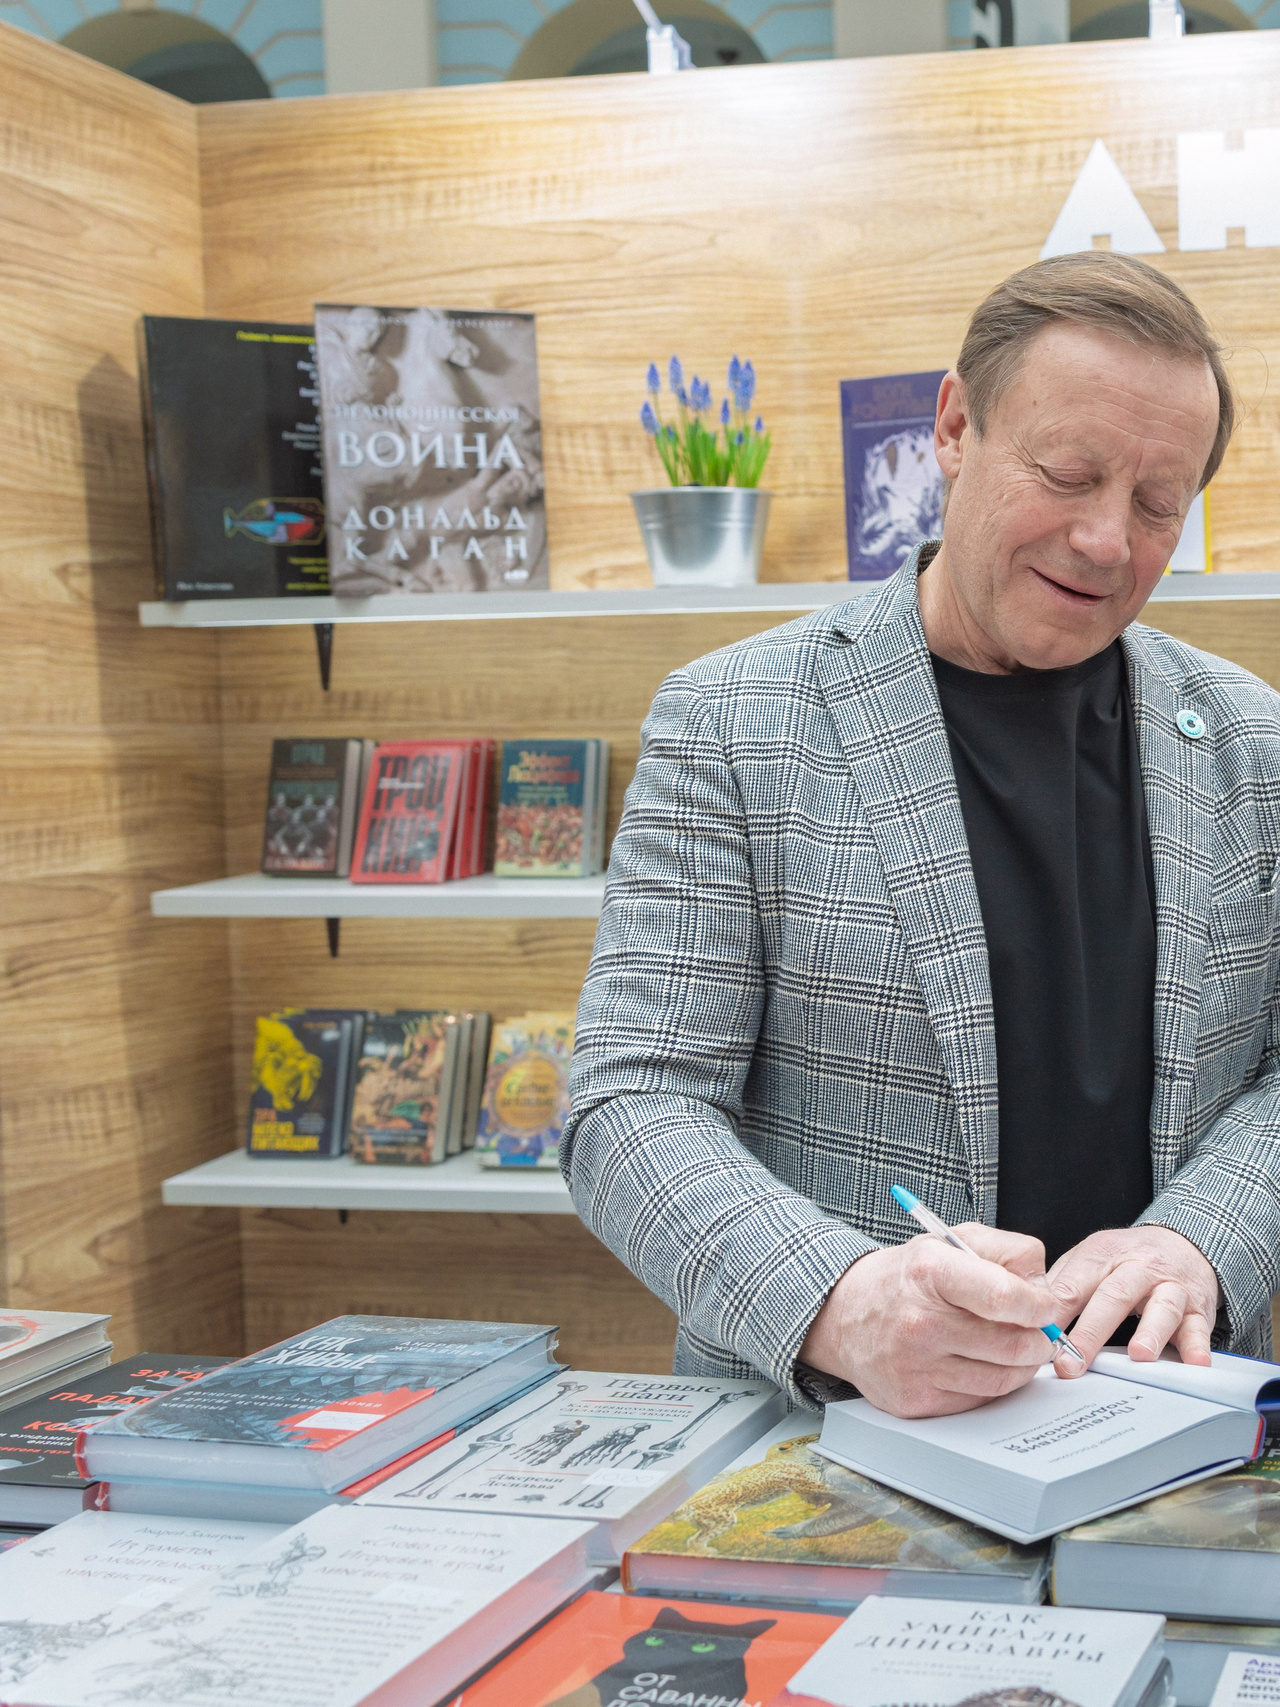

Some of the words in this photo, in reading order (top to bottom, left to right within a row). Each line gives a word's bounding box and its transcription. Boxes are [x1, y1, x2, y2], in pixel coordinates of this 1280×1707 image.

[338, 425, 525, 469] ВОЙНА
[342, 505, 528, 532] ДОНАЛЬД
[345, 535, 529, 560] КАГАН
[288, 1336, 365, 1351] КАК
[254, 1350, 388, 1369] ЖИВЫЕ
[130, 1369, 204, 1381] ЗАГА
[603, 1378, 721, 1393] Первые
[49, 1392, 155, 1404] ПАДА
[608, 1391, 690, 1401] шаги
[1017, 1406, 1136, 1453] Путешествие
[1022, 1400, 1129, 1444] подлинному
[971, 1609, 1043, 1625] КАК
[901, 1621, 1089, 1645] УМИРАЛИ
[854, 1634, 1106, 1663] ДИНОЗАВРЫ
[633, 1672, 677, 1687] ОТ
[1242, 1674, 1278, 1685] Как
